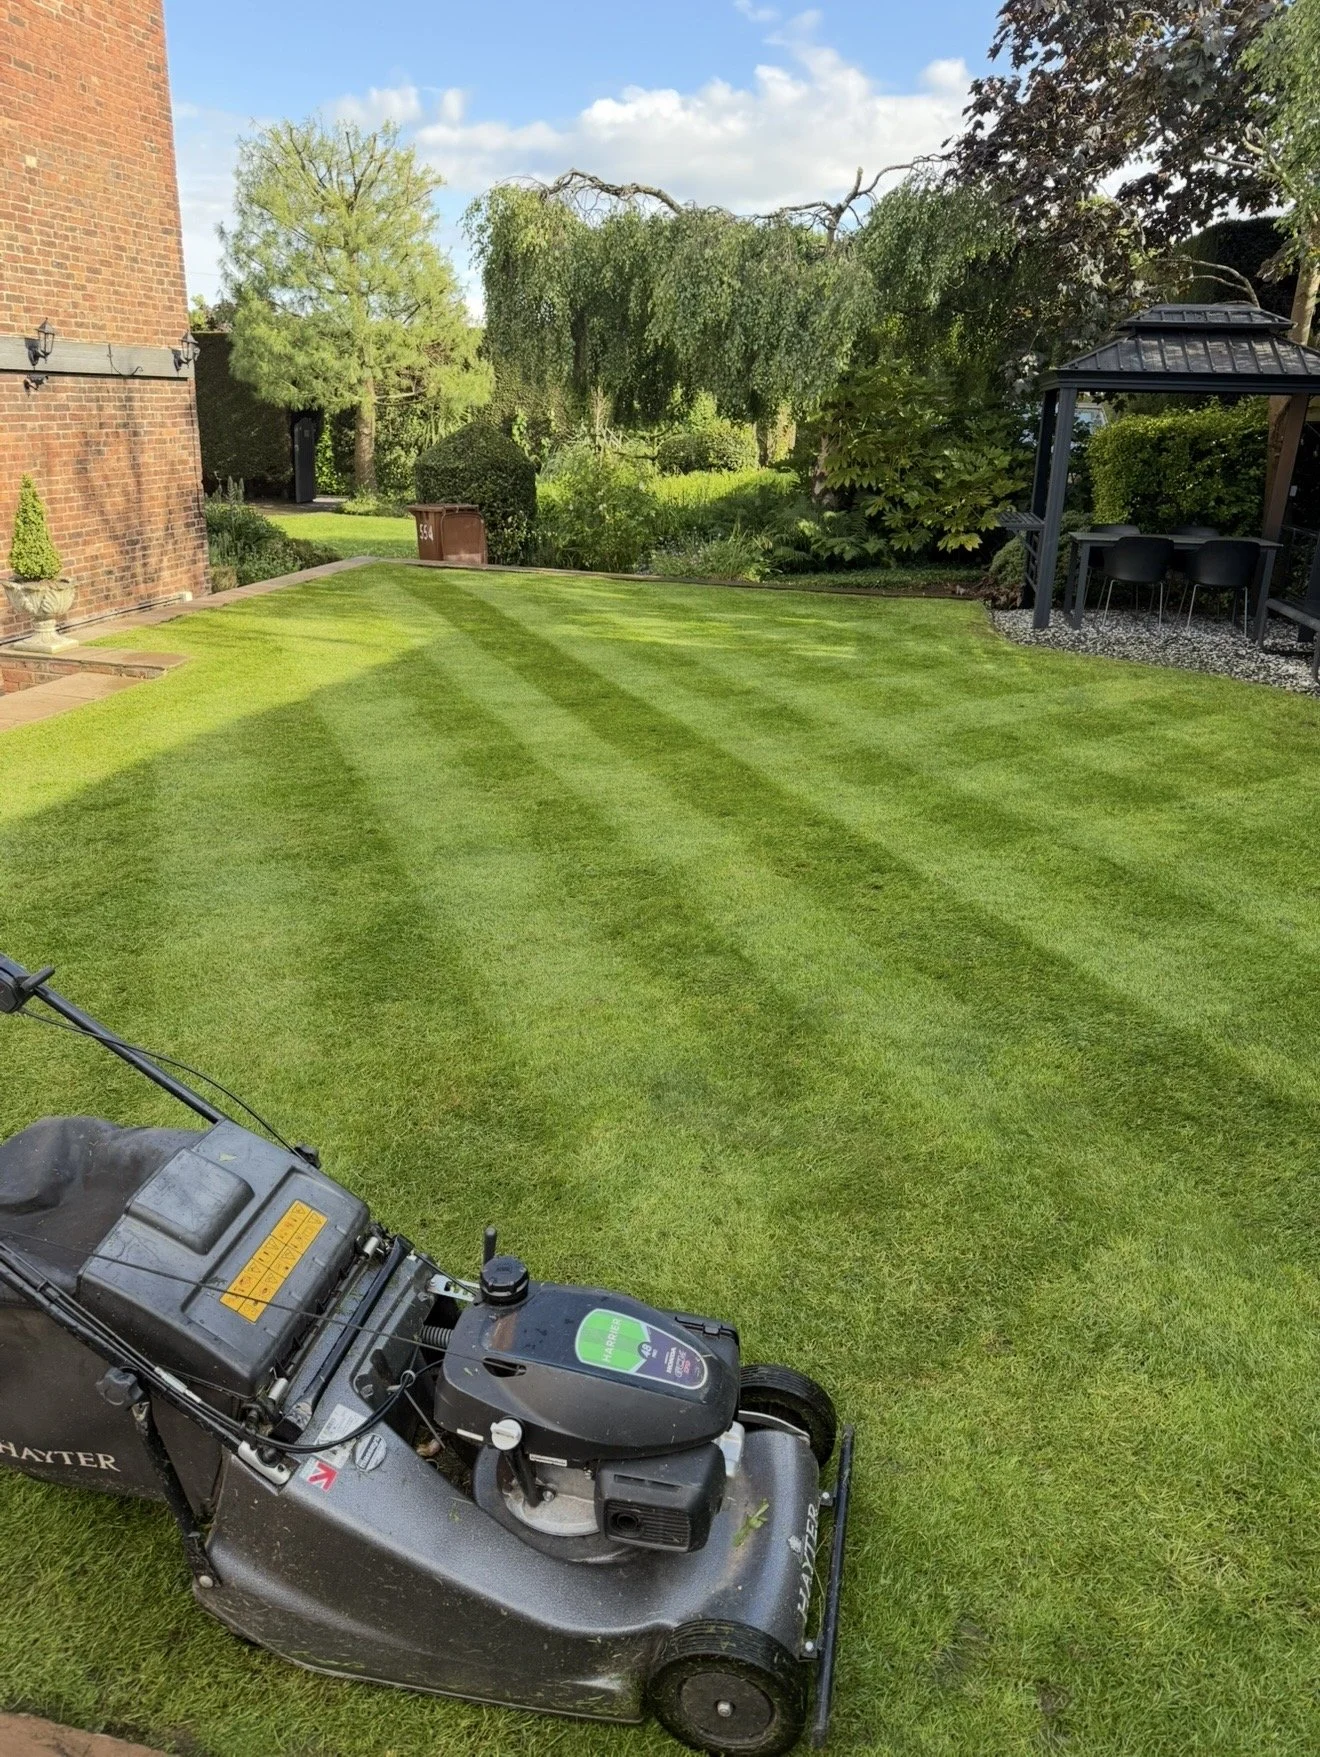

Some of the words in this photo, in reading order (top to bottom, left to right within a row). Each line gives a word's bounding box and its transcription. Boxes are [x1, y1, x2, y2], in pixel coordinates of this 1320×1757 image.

[602, 1318, 622, 1363] HARRIER
[641, 1343, 652, 1358] 48
[666, 1347, 677, 1374] HONDA
[0, 1441, 121, 1472] HAYTER
[797, 1503, 819, 1623] HAYTER
